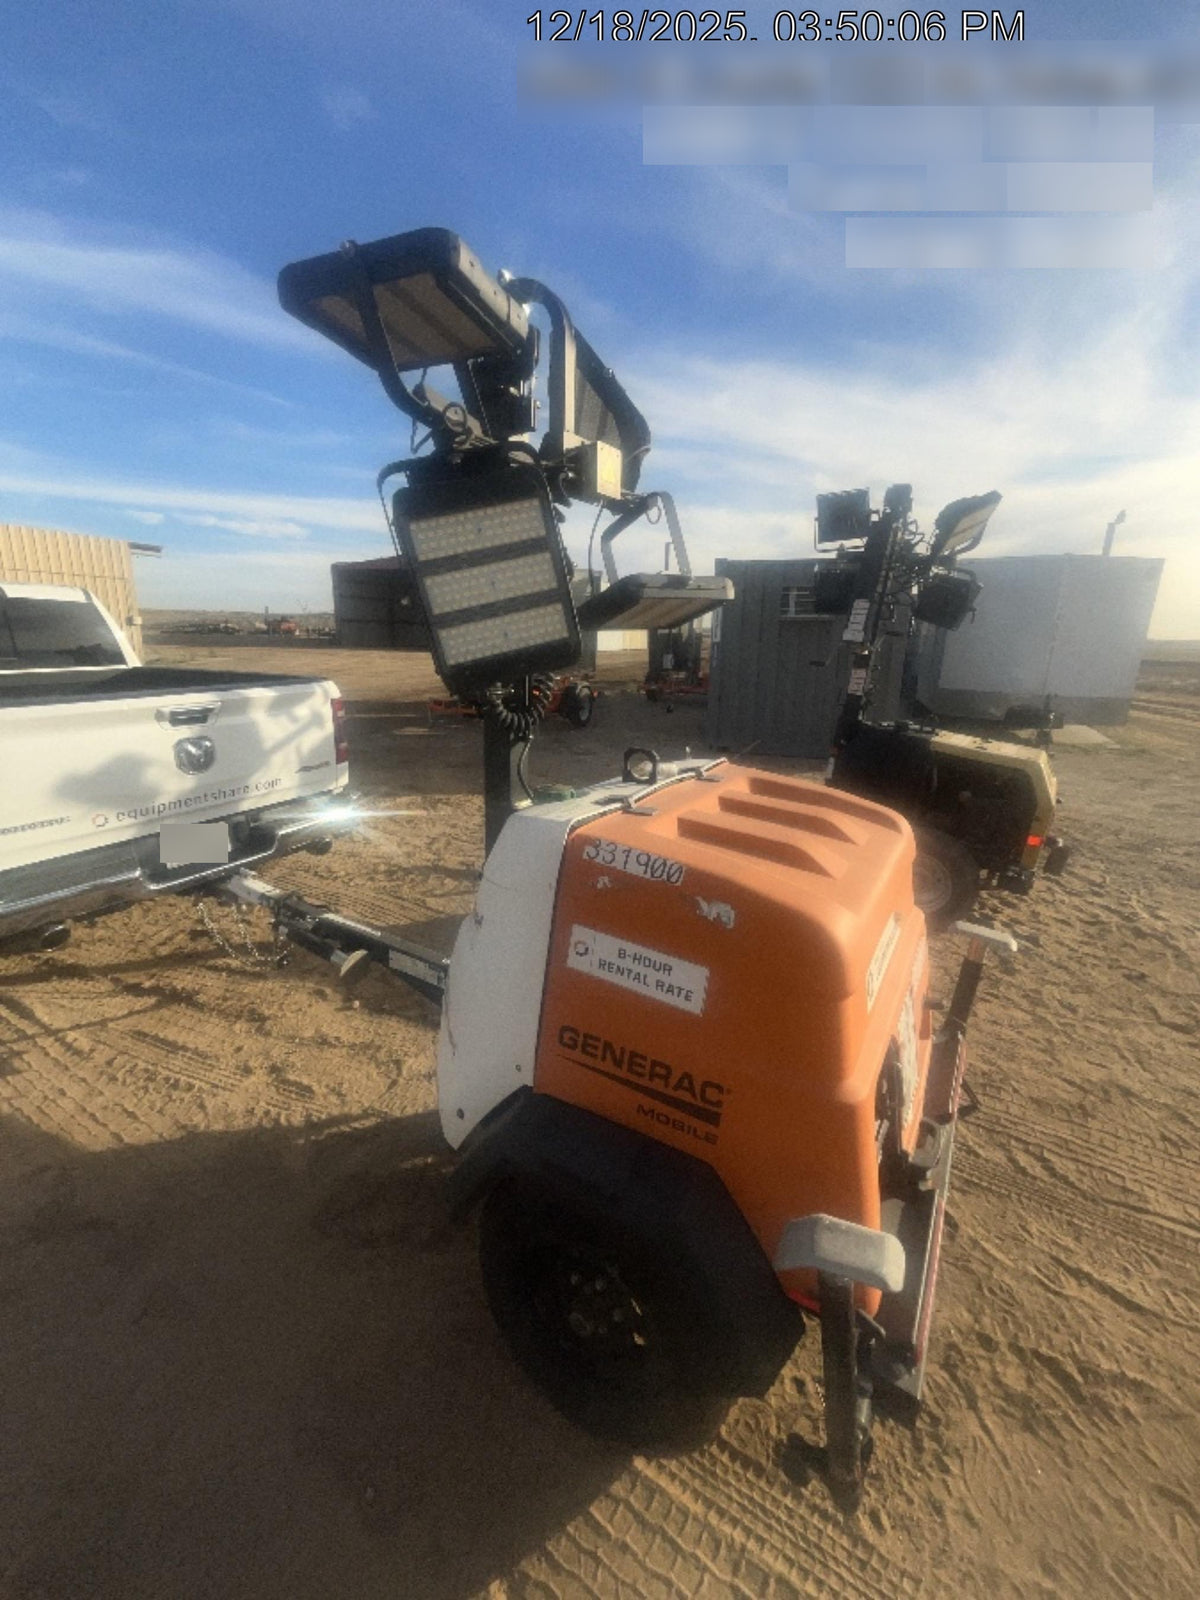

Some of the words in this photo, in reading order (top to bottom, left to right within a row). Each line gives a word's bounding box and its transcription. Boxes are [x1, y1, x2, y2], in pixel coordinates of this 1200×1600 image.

[116, 777, 283, 821] equipmentsharecom
[598, 958, 650, 988] RENTAL
[655, 979, 694, 1002] RATE
[558, 1024, 725, 1108] GENERAC
[636, 1103, 720, 1145] MOBILE
